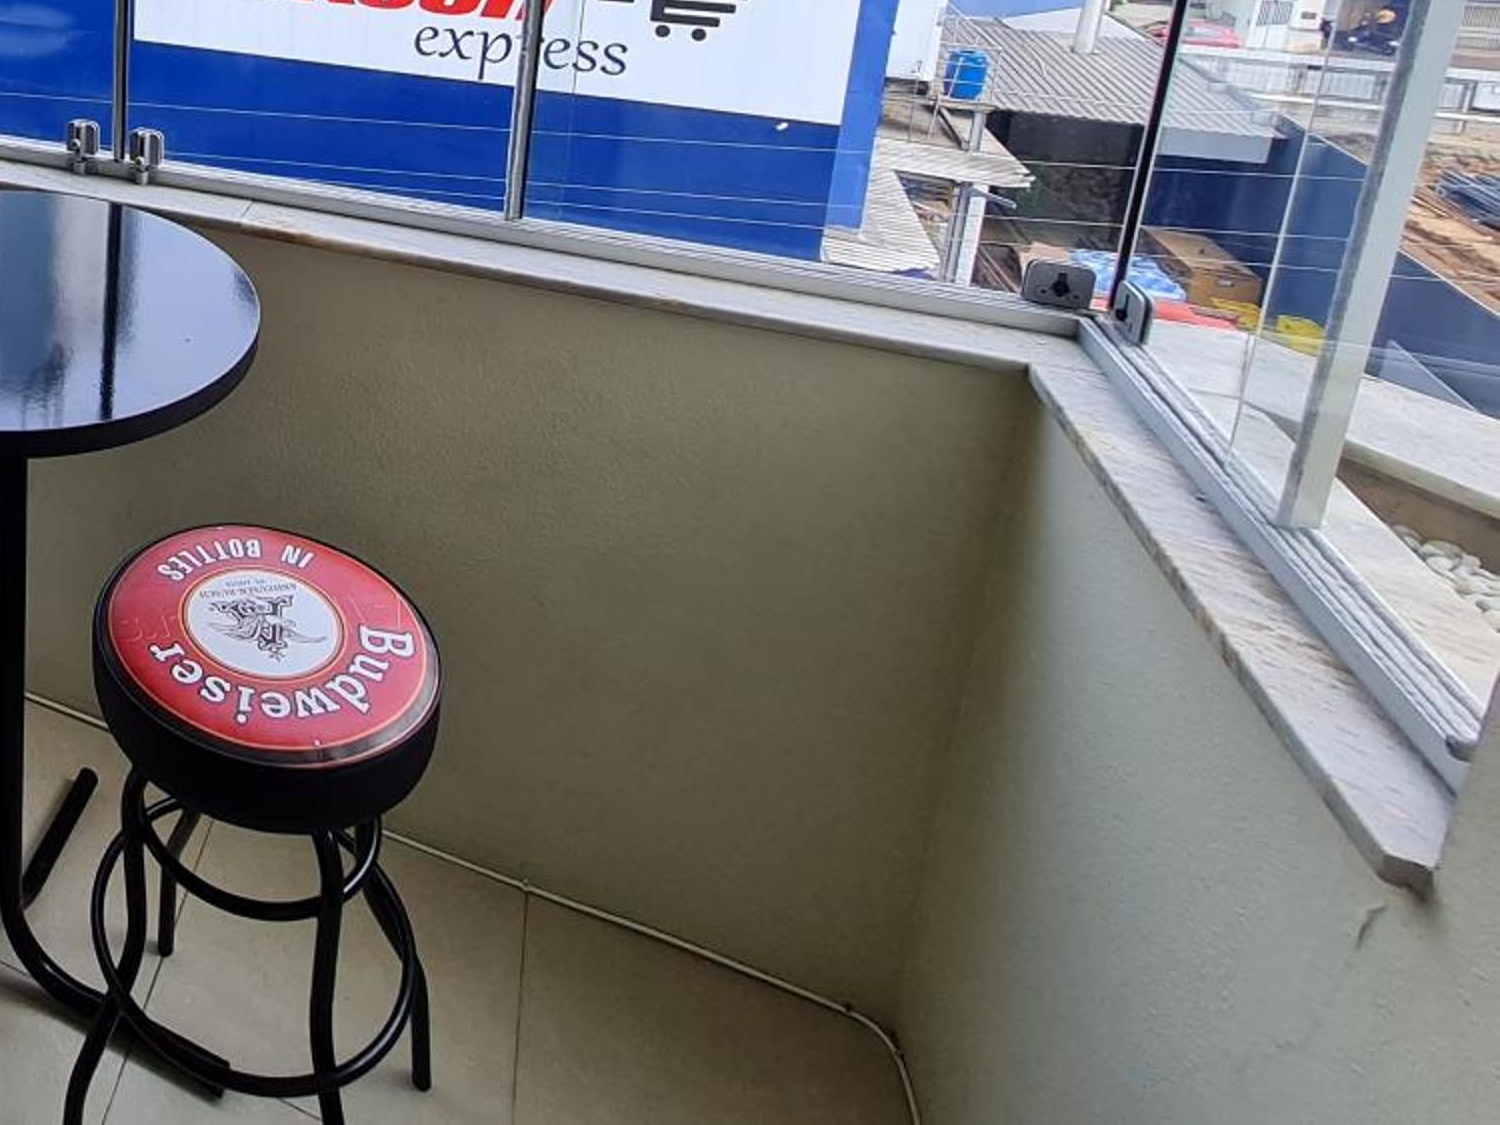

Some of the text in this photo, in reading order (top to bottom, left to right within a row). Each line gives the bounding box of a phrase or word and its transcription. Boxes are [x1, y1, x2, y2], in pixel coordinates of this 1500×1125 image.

[414, 26, 629, 80] expess
[157, 538, 314, 582] IN BOTTLES
[149, 625, 415, 724] Budweiser
